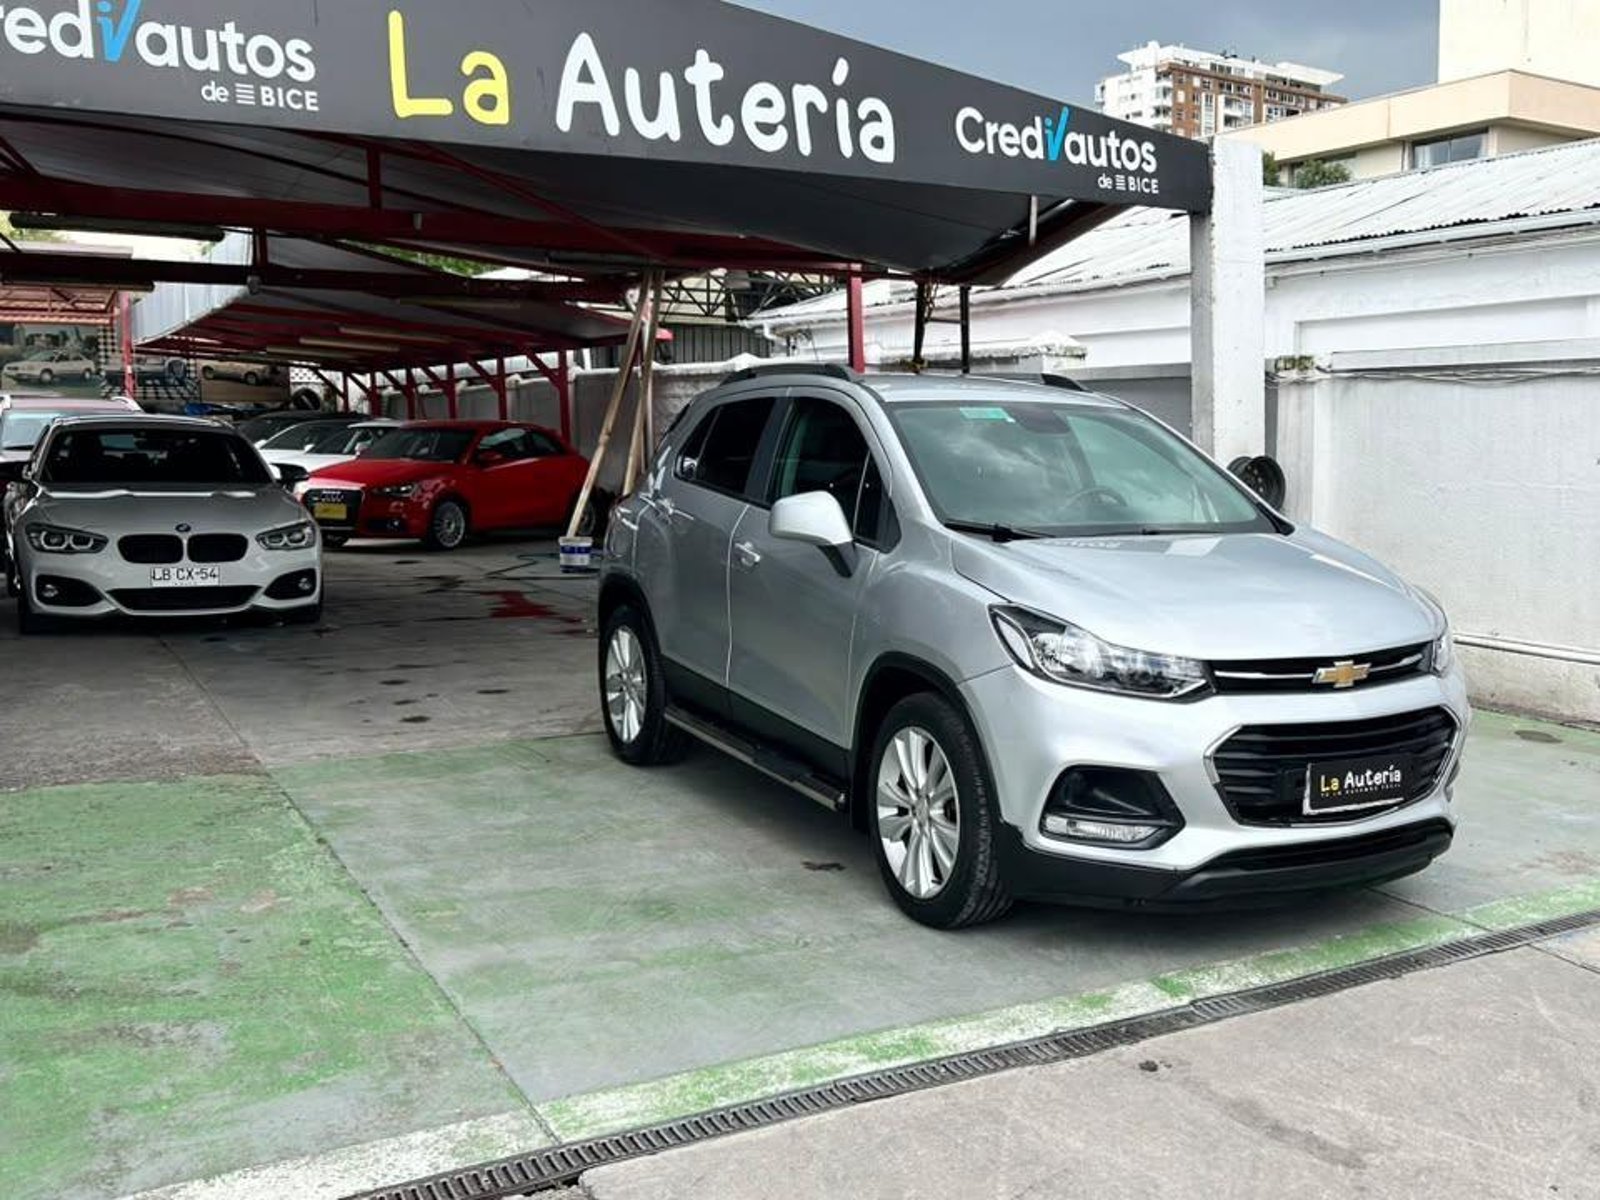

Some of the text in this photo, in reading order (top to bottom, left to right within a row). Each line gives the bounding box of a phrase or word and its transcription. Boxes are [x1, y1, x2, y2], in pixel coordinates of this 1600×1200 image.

[201, 81, 320, 112] de BICE
[388, 10, 895, 163] La Autería
[1097, 173, 1159, 194] de BICE
[152, 567, 217, 581] LB CX-54
[1320, 775, 1340, 792] La
[1344, 764, 1402, 789] Autería
